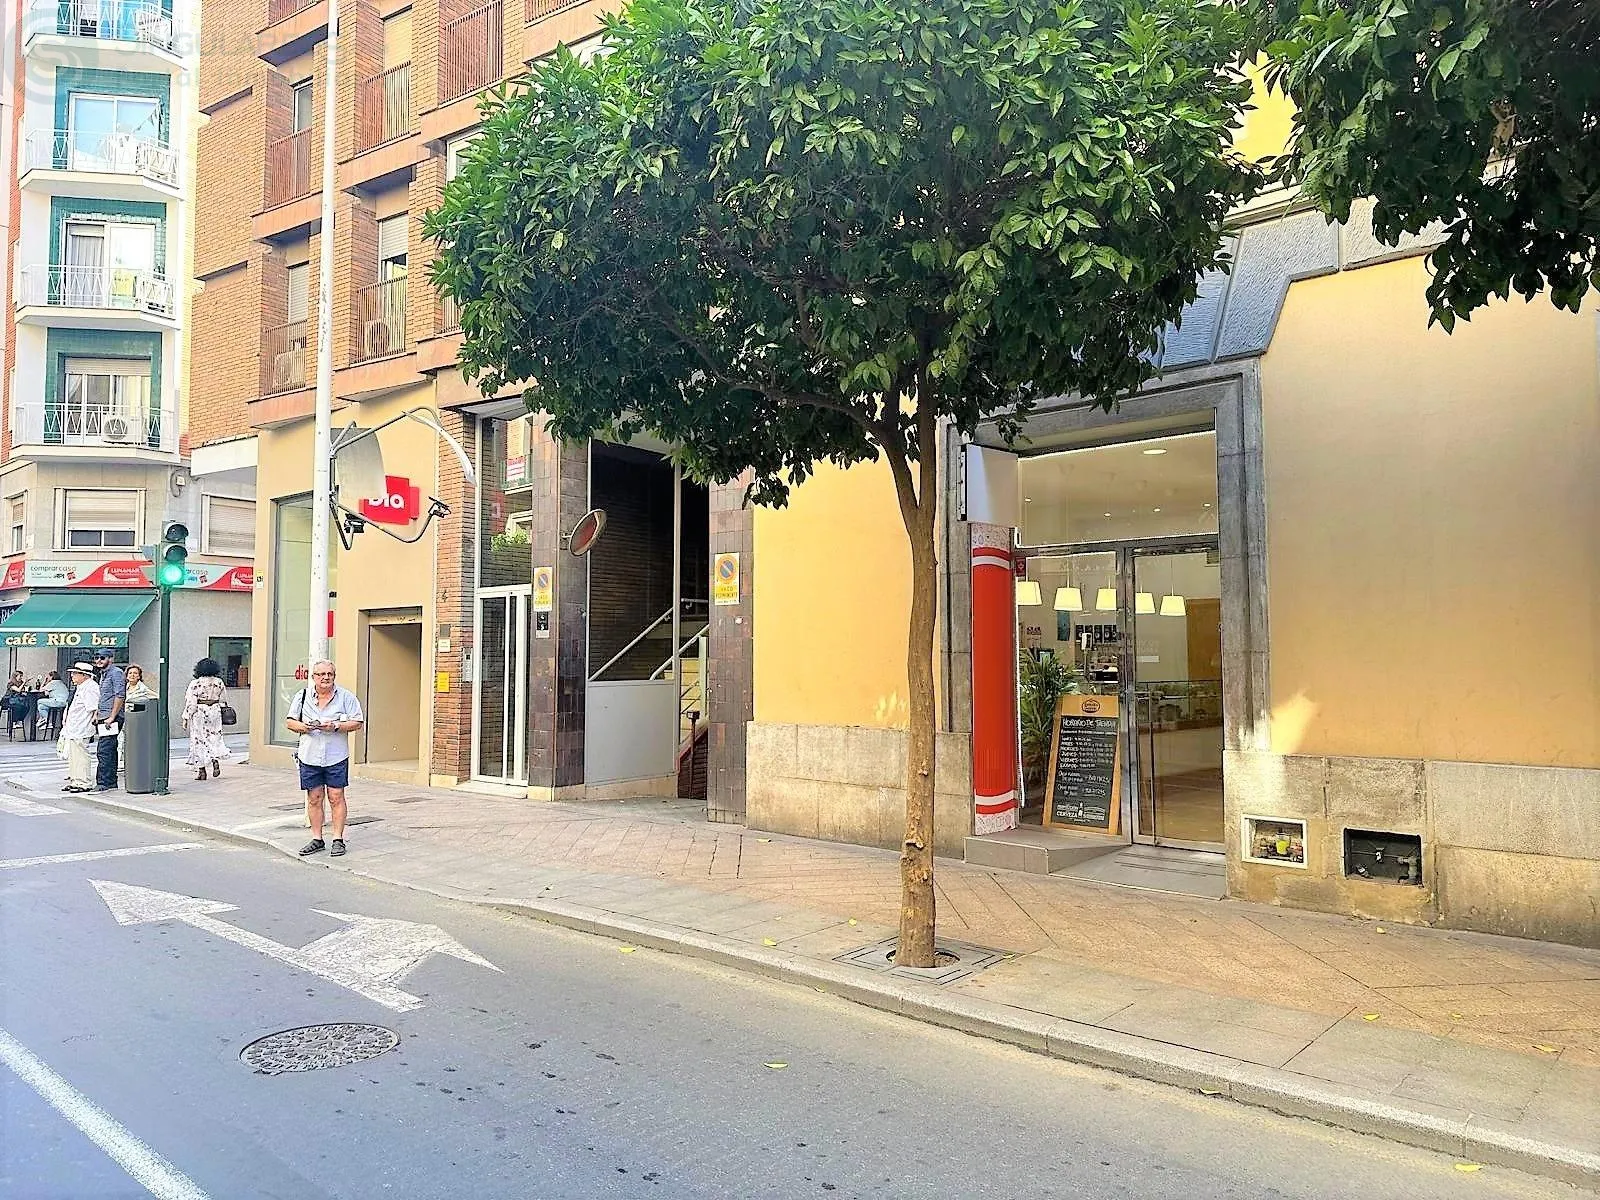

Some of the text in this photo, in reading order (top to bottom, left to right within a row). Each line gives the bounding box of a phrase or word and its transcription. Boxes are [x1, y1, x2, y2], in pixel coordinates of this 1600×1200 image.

[5, 632, 117, 646] café RIO bar
